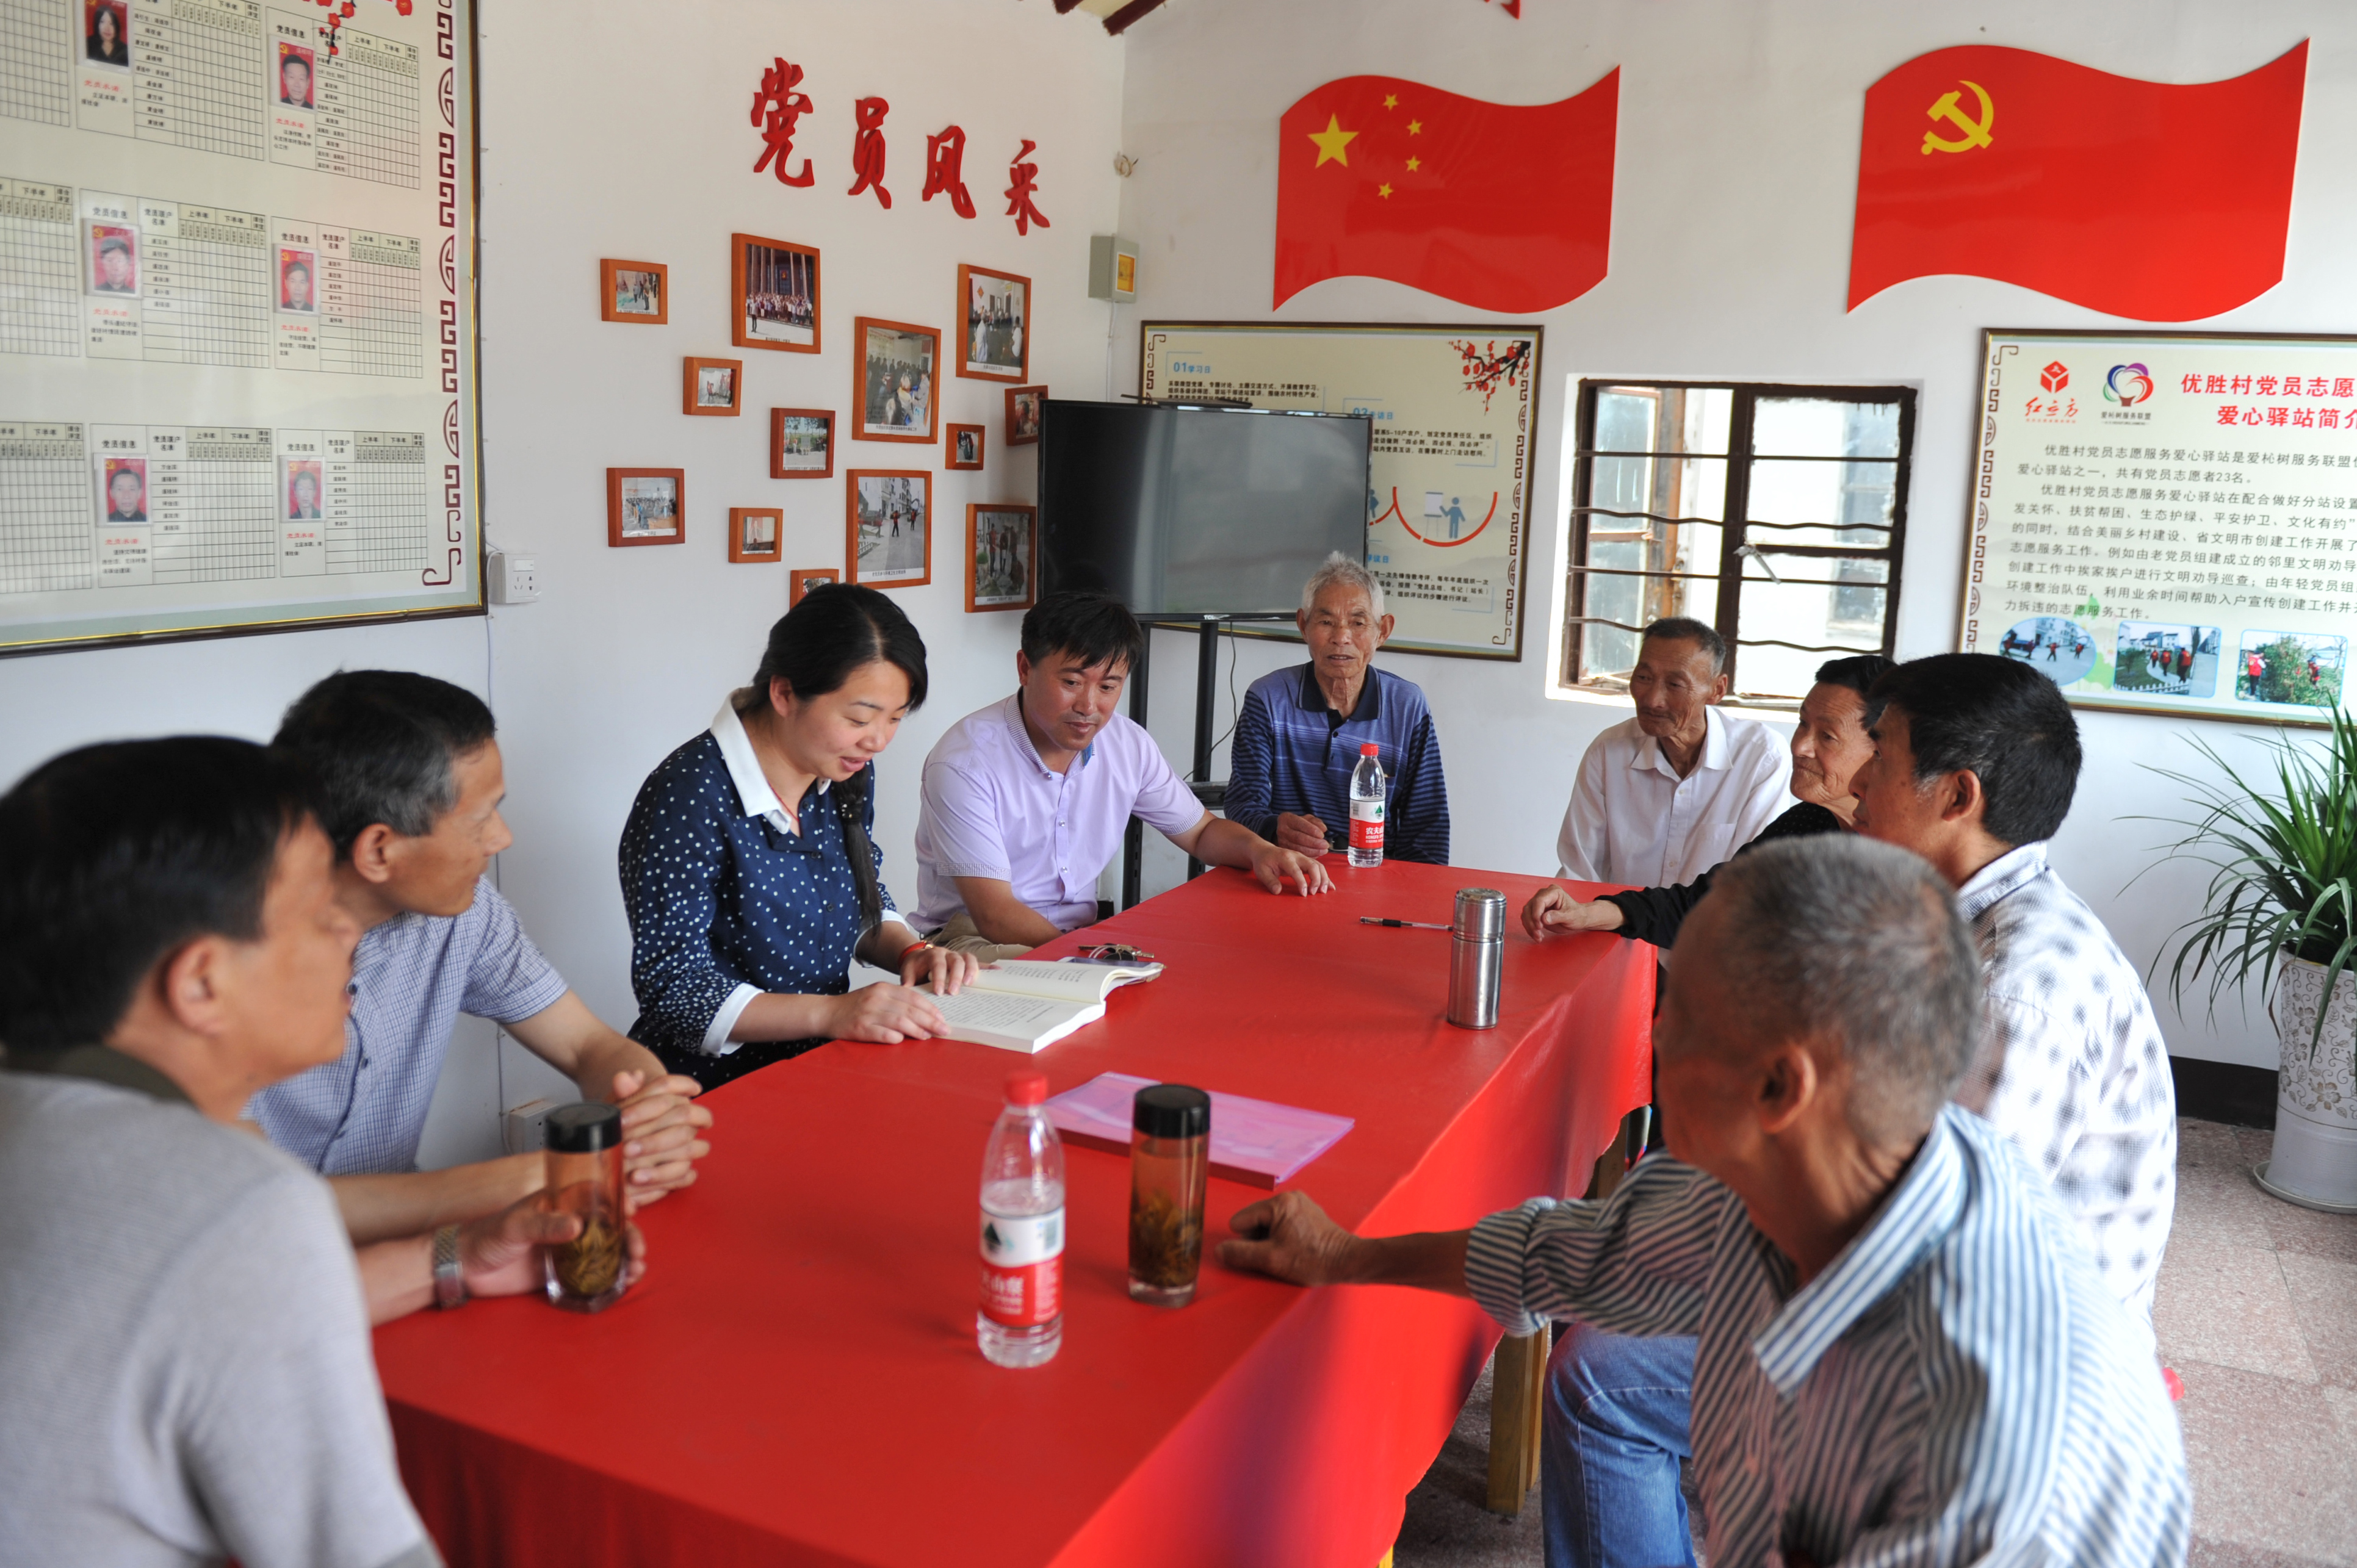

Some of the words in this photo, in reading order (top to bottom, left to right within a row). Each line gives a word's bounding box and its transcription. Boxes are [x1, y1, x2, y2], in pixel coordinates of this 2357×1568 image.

[218, 1, 237, 10] 下半年
[276, 25, 305, 38] 党员信息
[383, 44, 399, 52] 下半年
[751, 57, 1050, 236] 党员风采
[22, 187, 45, 196] 下半年
[93, 207, 128, 219] 党员信息
[281, 232, 309, 243] 党员信息
[1174, 362, 1211, 373] 01学习日
[2181, 373, 2355, 397] 优胜村党员志愿
[2025, 397, 2079, 417] 红立方
[102, 440, 136, 448] 党员信息
[2045, 444, 2357, 467] 优胜村党员志愿服务爱心驿站是爱杺树服务联盟
[2009, 561, 2357, 592] 创建工作中挨家挨户进行文明劝导巡查；由年轻党员组
[2006, 581, 2357, 613] 环境整治队伍，利用业余时间帮助入户宣传创建工作并
